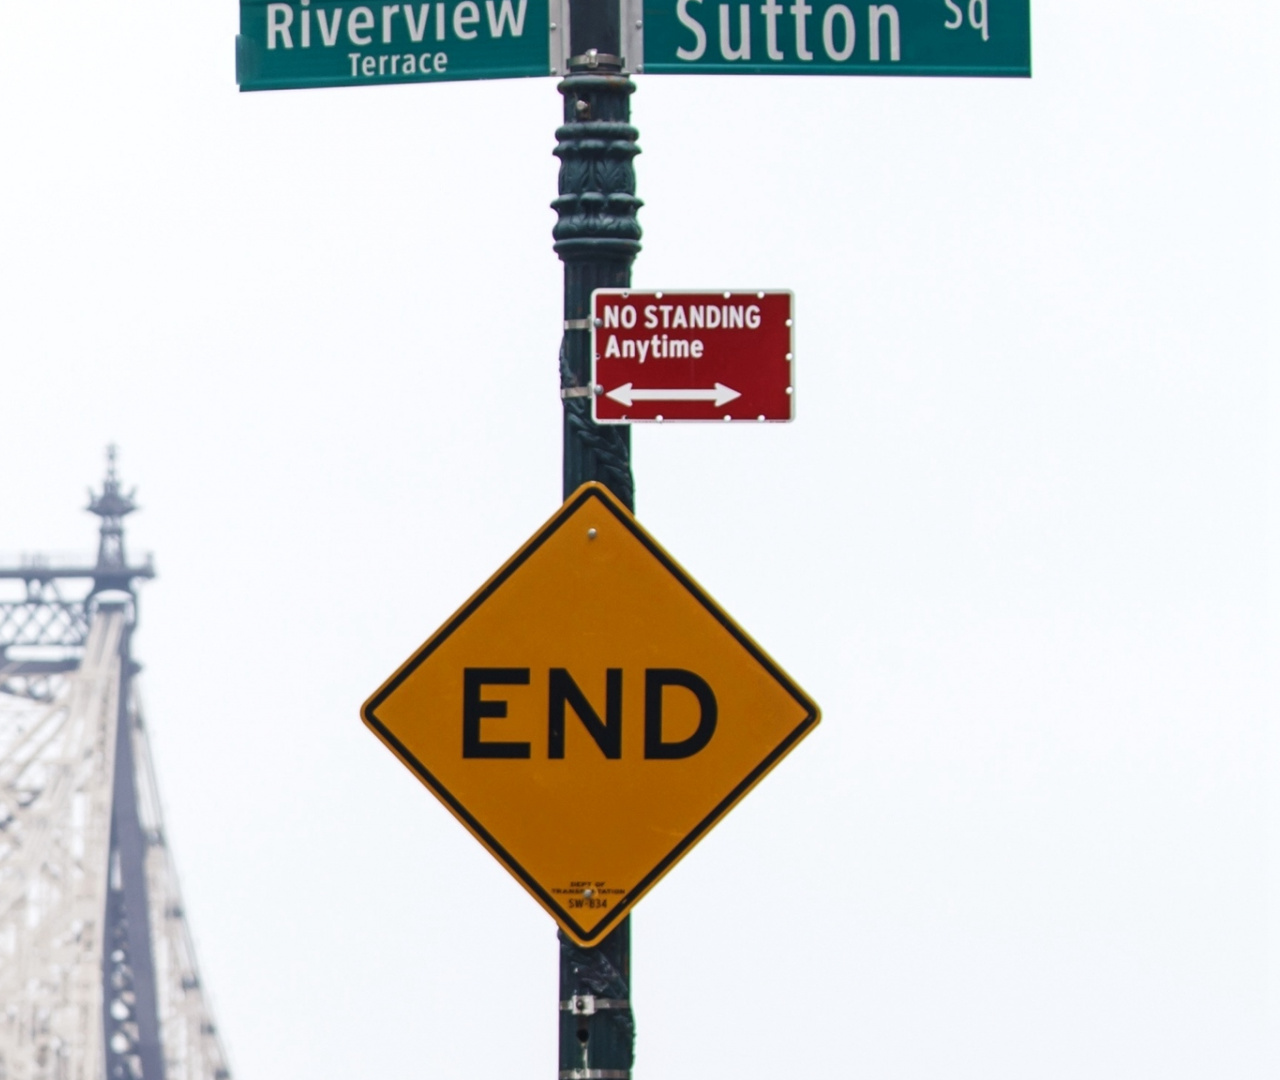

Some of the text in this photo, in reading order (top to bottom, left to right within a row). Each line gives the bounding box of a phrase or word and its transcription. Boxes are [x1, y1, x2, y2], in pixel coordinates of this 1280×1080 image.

[266, 0, 528, 50] Riverview
[675, 0, 990, 61] Sutton Sq
[348, 52, 448, 77] Terrace
[603, 304, 762, 330] NO STANDING
[604, 333, 705, 364] Anytime
[462, 667, 719, 760] END
[551, 887, 626, 895] TRANSPTATION
